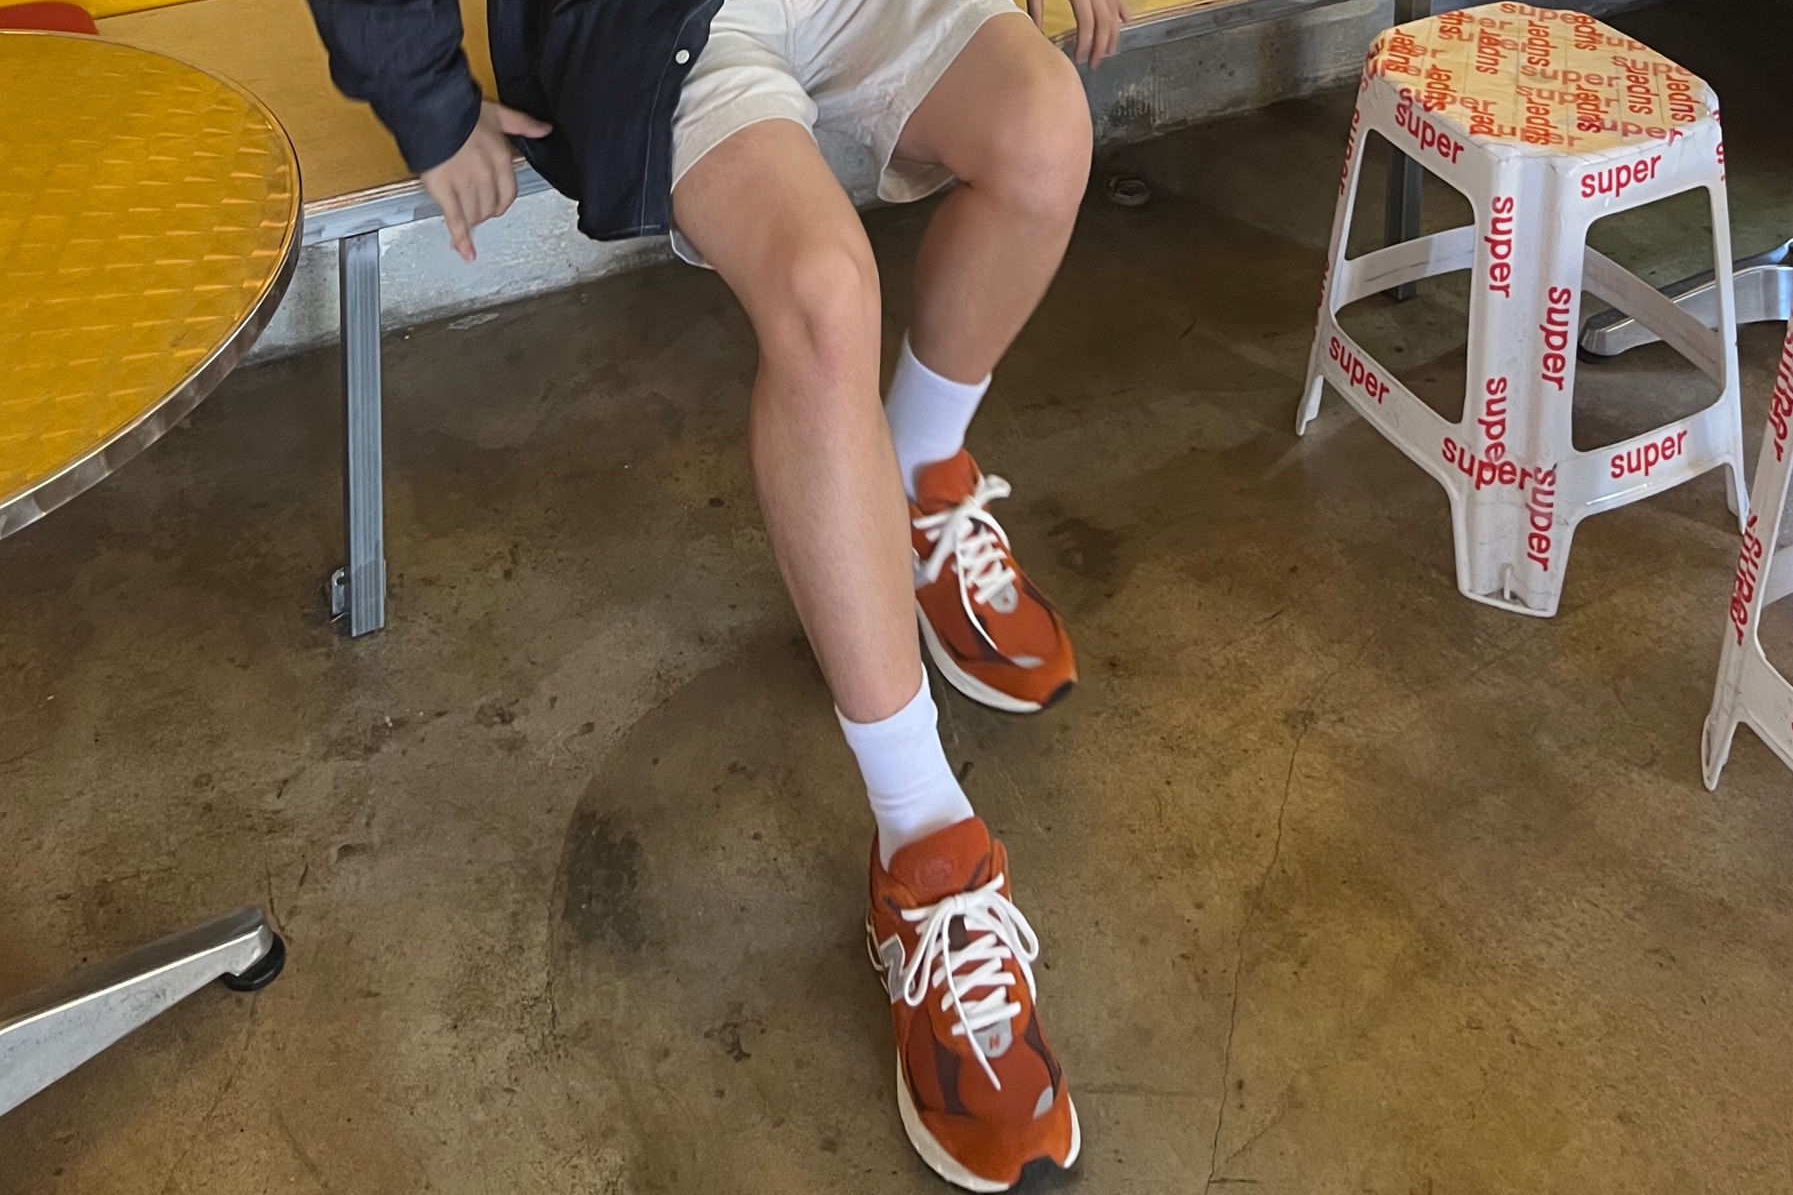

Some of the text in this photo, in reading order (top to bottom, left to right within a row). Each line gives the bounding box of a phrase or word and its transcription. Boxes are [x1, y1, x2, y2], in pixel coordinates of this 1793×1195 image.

[1476, 28, 1508, 75] super
[1527, 20, 1558, 67] super
[1519, 65, 1621, 88] super
[1625, 65, 1660, 115] super
[1666, 74, 1704, 123] super
[1395, 103, 1464, 164] super
[1525, 97, 1559, 146] super
[1576, 83, 1609, 134] super
[1580, 155, 1661, 199] super
[1484, 195, 1514, 298] super
[1541, 286, 1572, 391] super
[1330, 336, 1390, 404] super
[1478, 377, 1507, 472] supe
[1441, 436, 1533, 490] super
[1610, 429, 1688, 479] super
[1525, 466, 1557, 572] super
